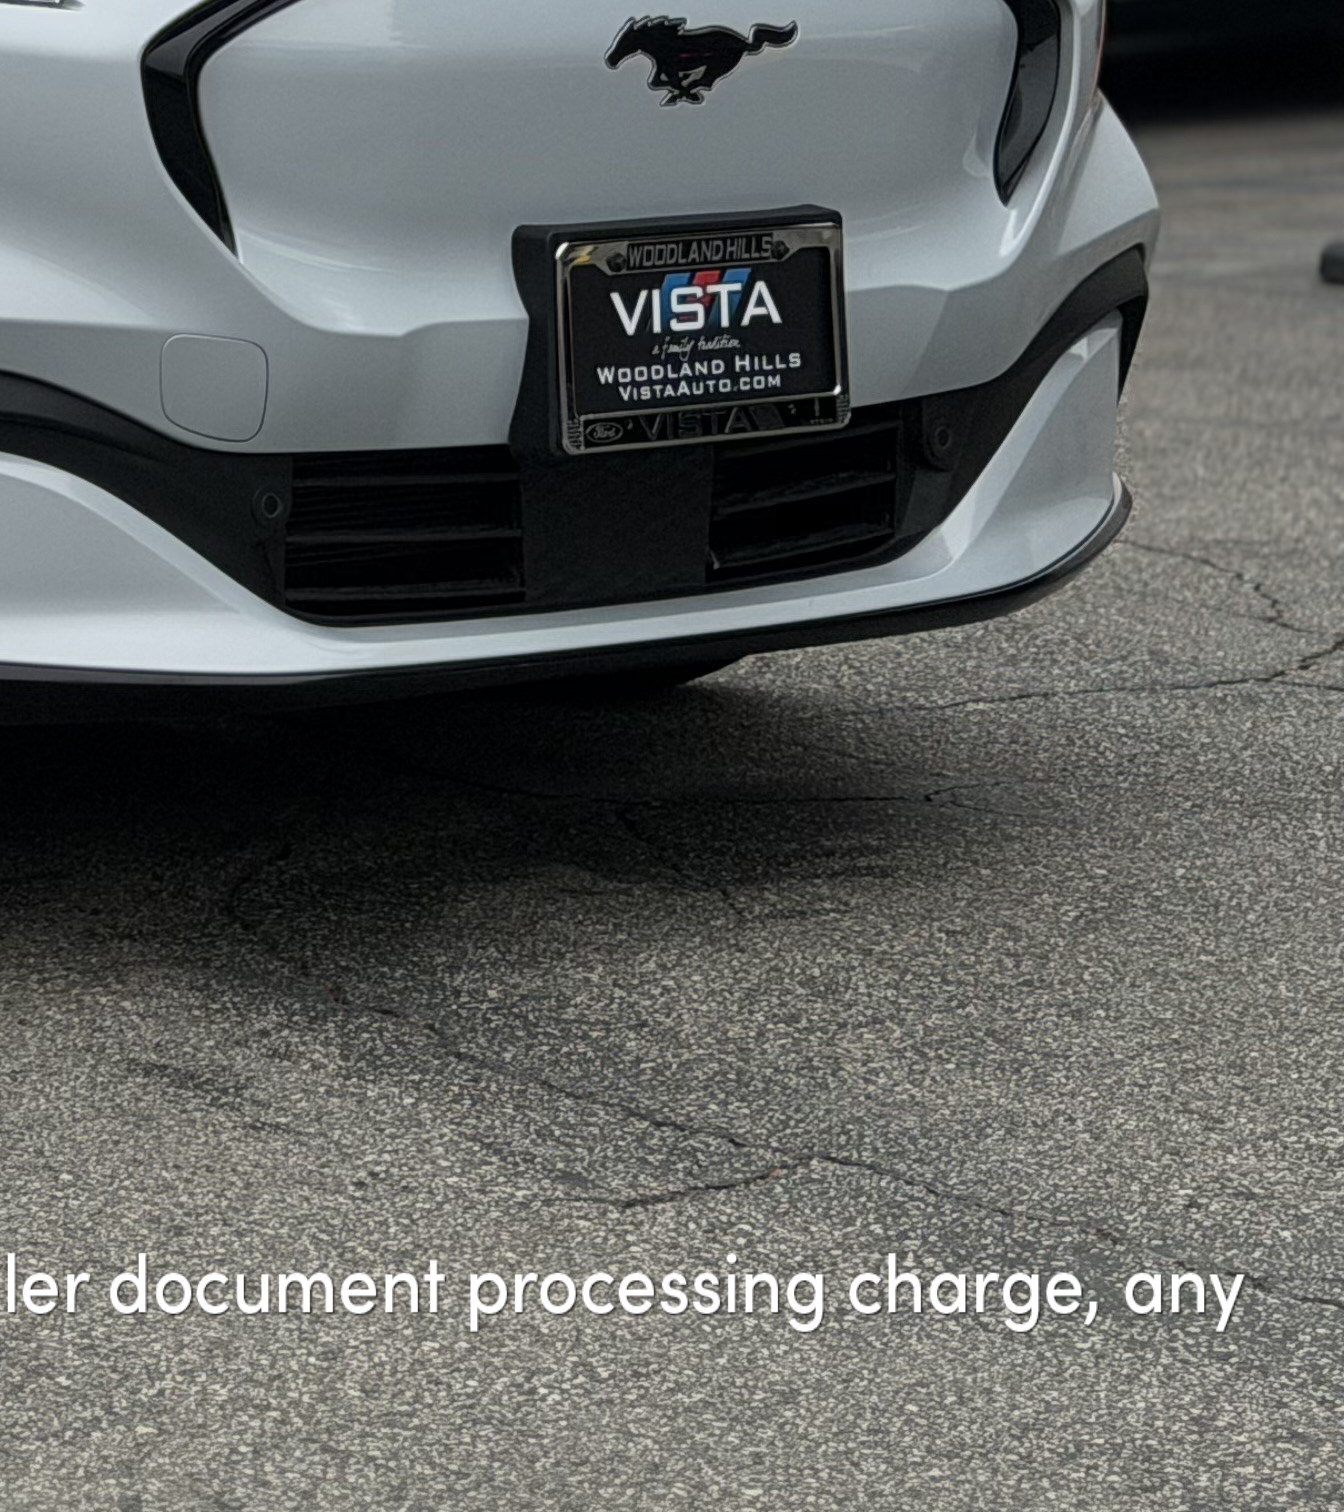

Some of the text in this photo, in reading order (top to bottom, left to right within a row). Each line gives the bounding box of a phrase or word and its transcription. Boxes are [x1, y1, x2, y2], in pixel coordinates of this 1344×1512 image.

[627, 236, 772, 268] WOODLAND HILLS
[609, 280, 783, 336] VISTA
[596, 352, 802, 385] WOODLAND HILLS
[639, 406, 753, 441] VISTA
